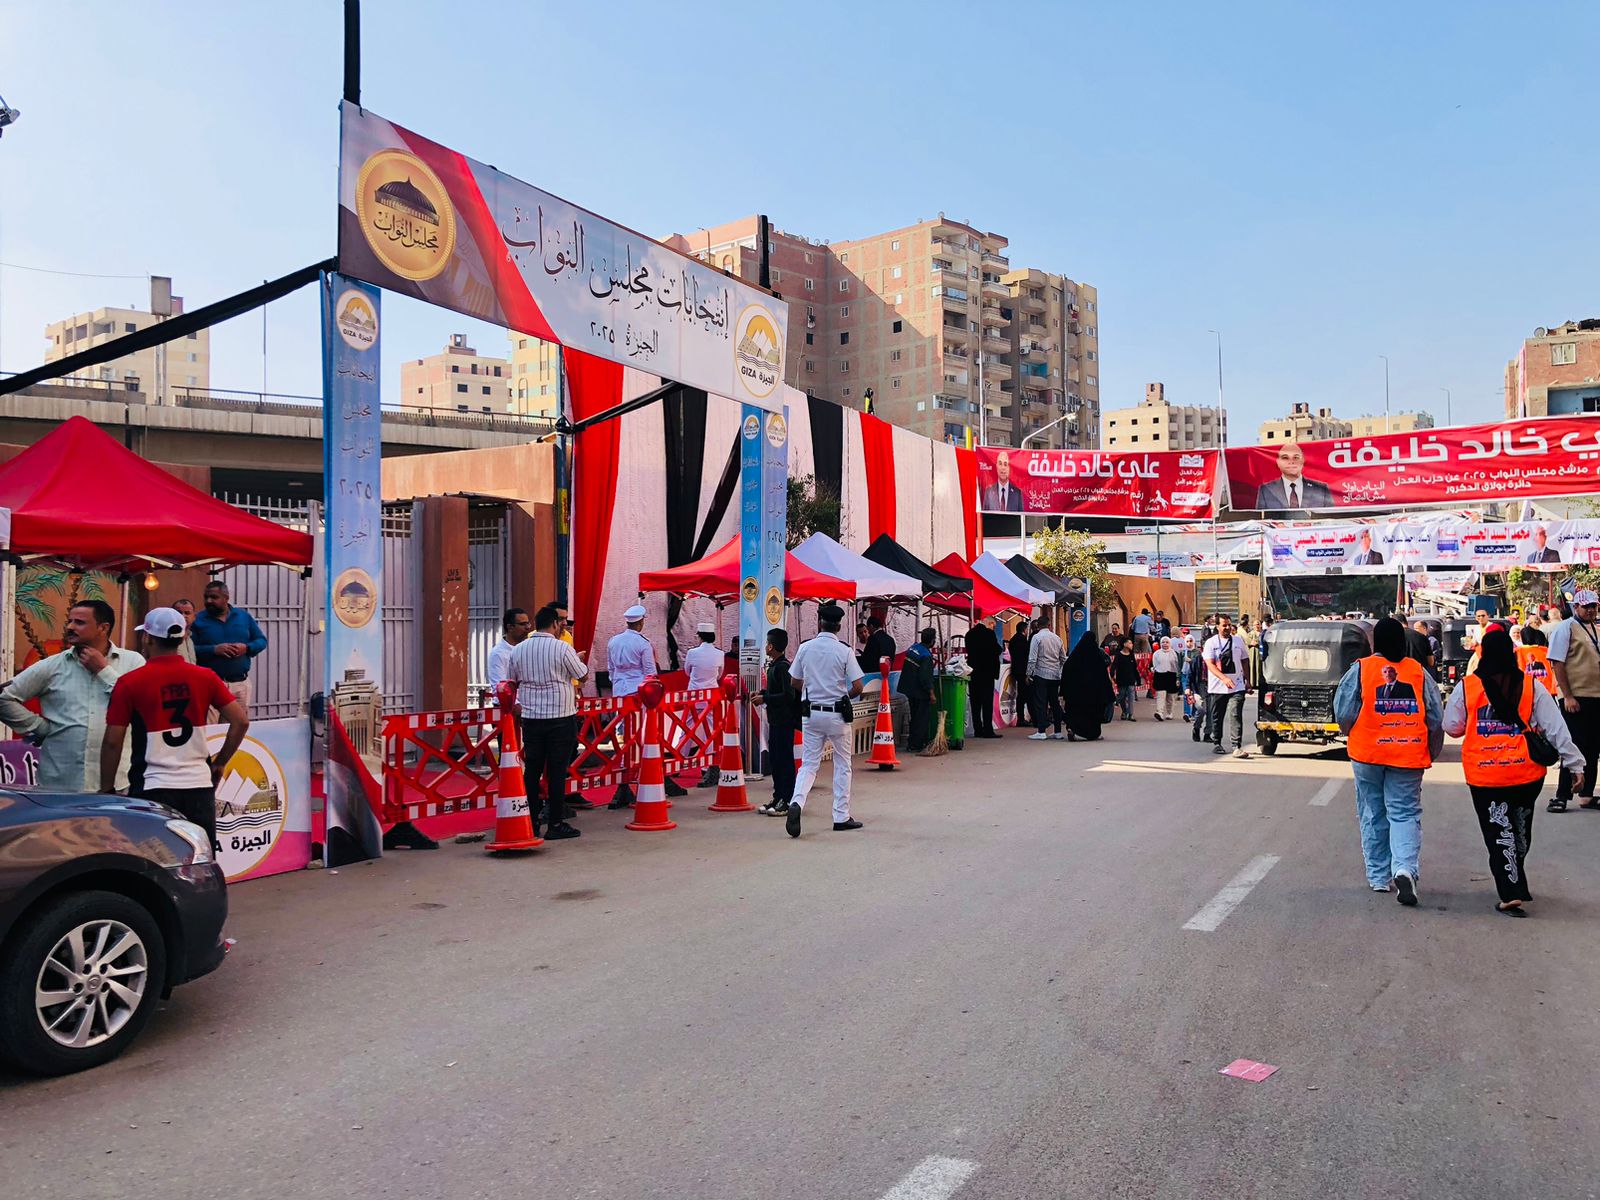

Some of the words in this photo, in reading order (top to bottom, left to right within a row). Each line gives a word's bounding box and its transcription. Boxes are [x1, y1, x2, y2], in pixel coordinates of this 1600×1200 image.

[373, 210, 412, 247] النواب
[400, 227, 439, 252] مجلس
[501, 205, 585, 277] النواب
[588, 244, 653, 304] مجلس
[590, 320, 616, 344] ٢٠٢٥
[625, 327, 659, 358] الجيزة
[741, 365, 757, 380] GIZA
[758, 371, 775, 386] الجيزة
[1458, 428, 1549, 460] خالد
[1328, 435, 1449, 473] خليفة
[1027, 453, 1077, 483] خليفة
[1079, 453, 1114, 478] خالد
[1117, 454, 1160, 485] علي
[1558, 463, 1589, 476] مرشح
[1393, 475, 1421, 486] العدل
[1423, 474, 1444, 484] حزب
[1445, 473, 1460, 483] عن
[1463, 471, 1486, 481] ٢٠٢٥
[1489, 468, 1520, 480] النواب
[1522, 468, 1556, 479] مجلس
[340, 478, 372, 500] ٢٠٢٥
[1445, 482, 1480, 495] الدكرور
[1481, 481, 1506, 491] بولاق
[1507, 480, 1532, 490] دائرة
[1130, 490, 1144, 500] رقم
[1132, 501, 1140, 513] ١٤
[162, 699, 193, 747] 3
[721, 774, 738, 783] مرور
[231, 830, 271, 852] الجيزة
